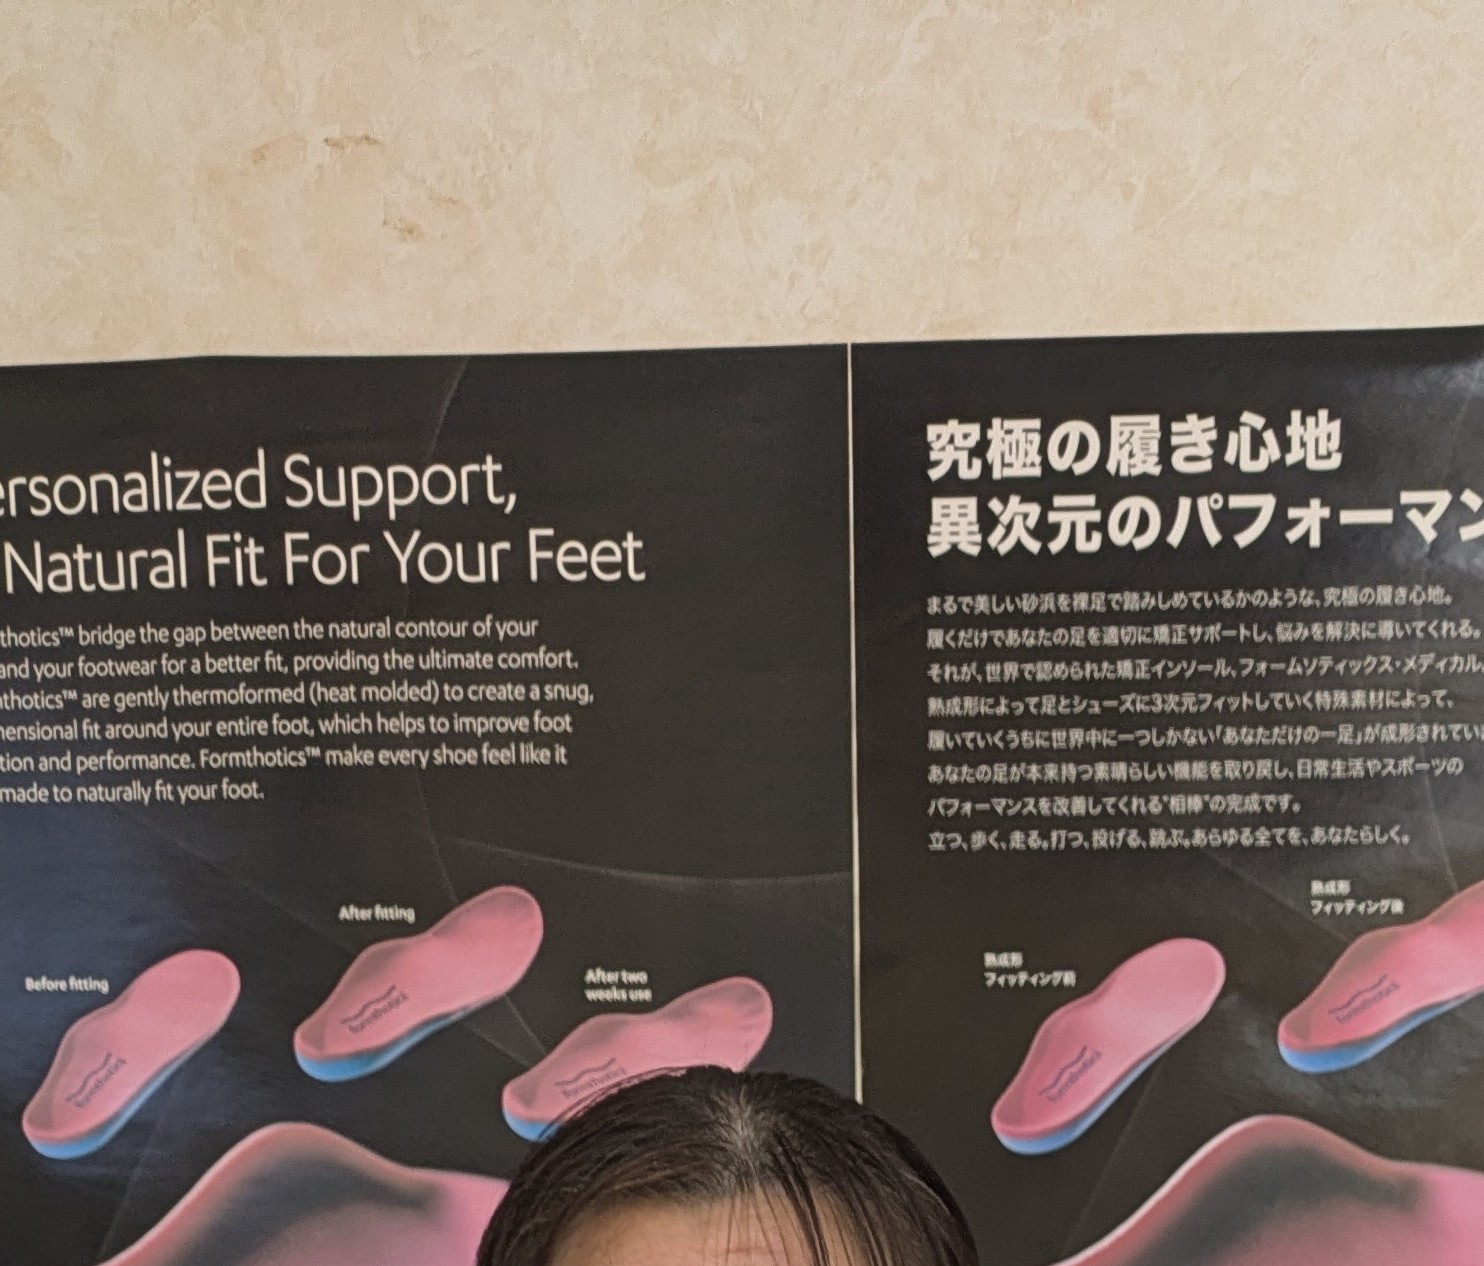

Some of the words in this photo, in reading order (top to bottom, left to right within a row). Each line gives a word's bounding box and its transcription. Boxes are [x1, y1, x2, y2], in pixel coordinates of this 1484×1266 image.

[927, 409, 1342, 481] 究極の履き心地
[0, 448, 266, 517] rsonalized
[284, 453, 516, 521] Support,
[4, 528, 187, 594] Natural
[207, 532, 267, 587] Fit
[285, 532, 370, 585] For
[383, 530, 510, 583] Your
[529, 528, 645, 582] Feet
[78, 623, 136, 649] bridge
[139, 622, 169, 644] the
[173, 626, 206, 647] gap
[210, 620, 289, 641] between
[293, 617, 324, 640] the
[328, 616, 390, 639] natural
[395, 619, 468, 638] contour
[473, 614, 493, 637] of
[495, 620, 538, 642] your
[33, 663, 74, 682] your
[78, 655, 157, 677] footwear
[161, 653, 187, 674] for
[191, 658, 201, 674] a
[205, 652, 260, 674] better
[264, 650, 288, 674] fit,
[293, 649, 379, 676] providing
[383, 648, 414, 670] the
[418, 647, 493, 669] ultimate
[497, 645, 578, 669] comfort.
[82, 693, 110, 708] are
[114, 685, 169, 712] gently
[173, 681, 305, 706] thermoformed
[309, 681, 357, 706] (heat
[361, 680, 439, 704] molded)
[443, 683, 463, 701] to
[467, 682, 525, 701] create
[530, 684, 540, 700] a
[544, 684, 593, 705] snug,
[82, 718, 101, 740] fit
[105, 717, 168, 739] around
[172, 718, 212, 742] your
[216, 716, 268, 737] entire
[272, 713, 314, 737] foot,
[318, 712, 372, 734] which
[377, 711, 425, 738] helps
[429, 715, 449, 733] to
[453, 713, 529, 737] improve
[533, 709, 573, 733] foot
[39, 751, 71, 772] and
[76, 749, 195, 775] performance.
[325, 743, 374, 766] make
[378, 749, 429, 769] every
[433, 743, 478, 765] shoe
[481, 742, 516, 765] feel
[520, 742, 551, 765] like
[554, 744, 567, 764] it
[52, 785, 72, 802] to
[77, 780, 151, 805] naturally
[155, 779, 174, 801] fit
[176, 784, 218, 804] your
[221, 777, 264, 800] foot.
[339, 904, 373, 920] After
[25, 975, 67, 991] Before
[69, 976, 109, 994] fitting
[585, 967, 619, 984] After
